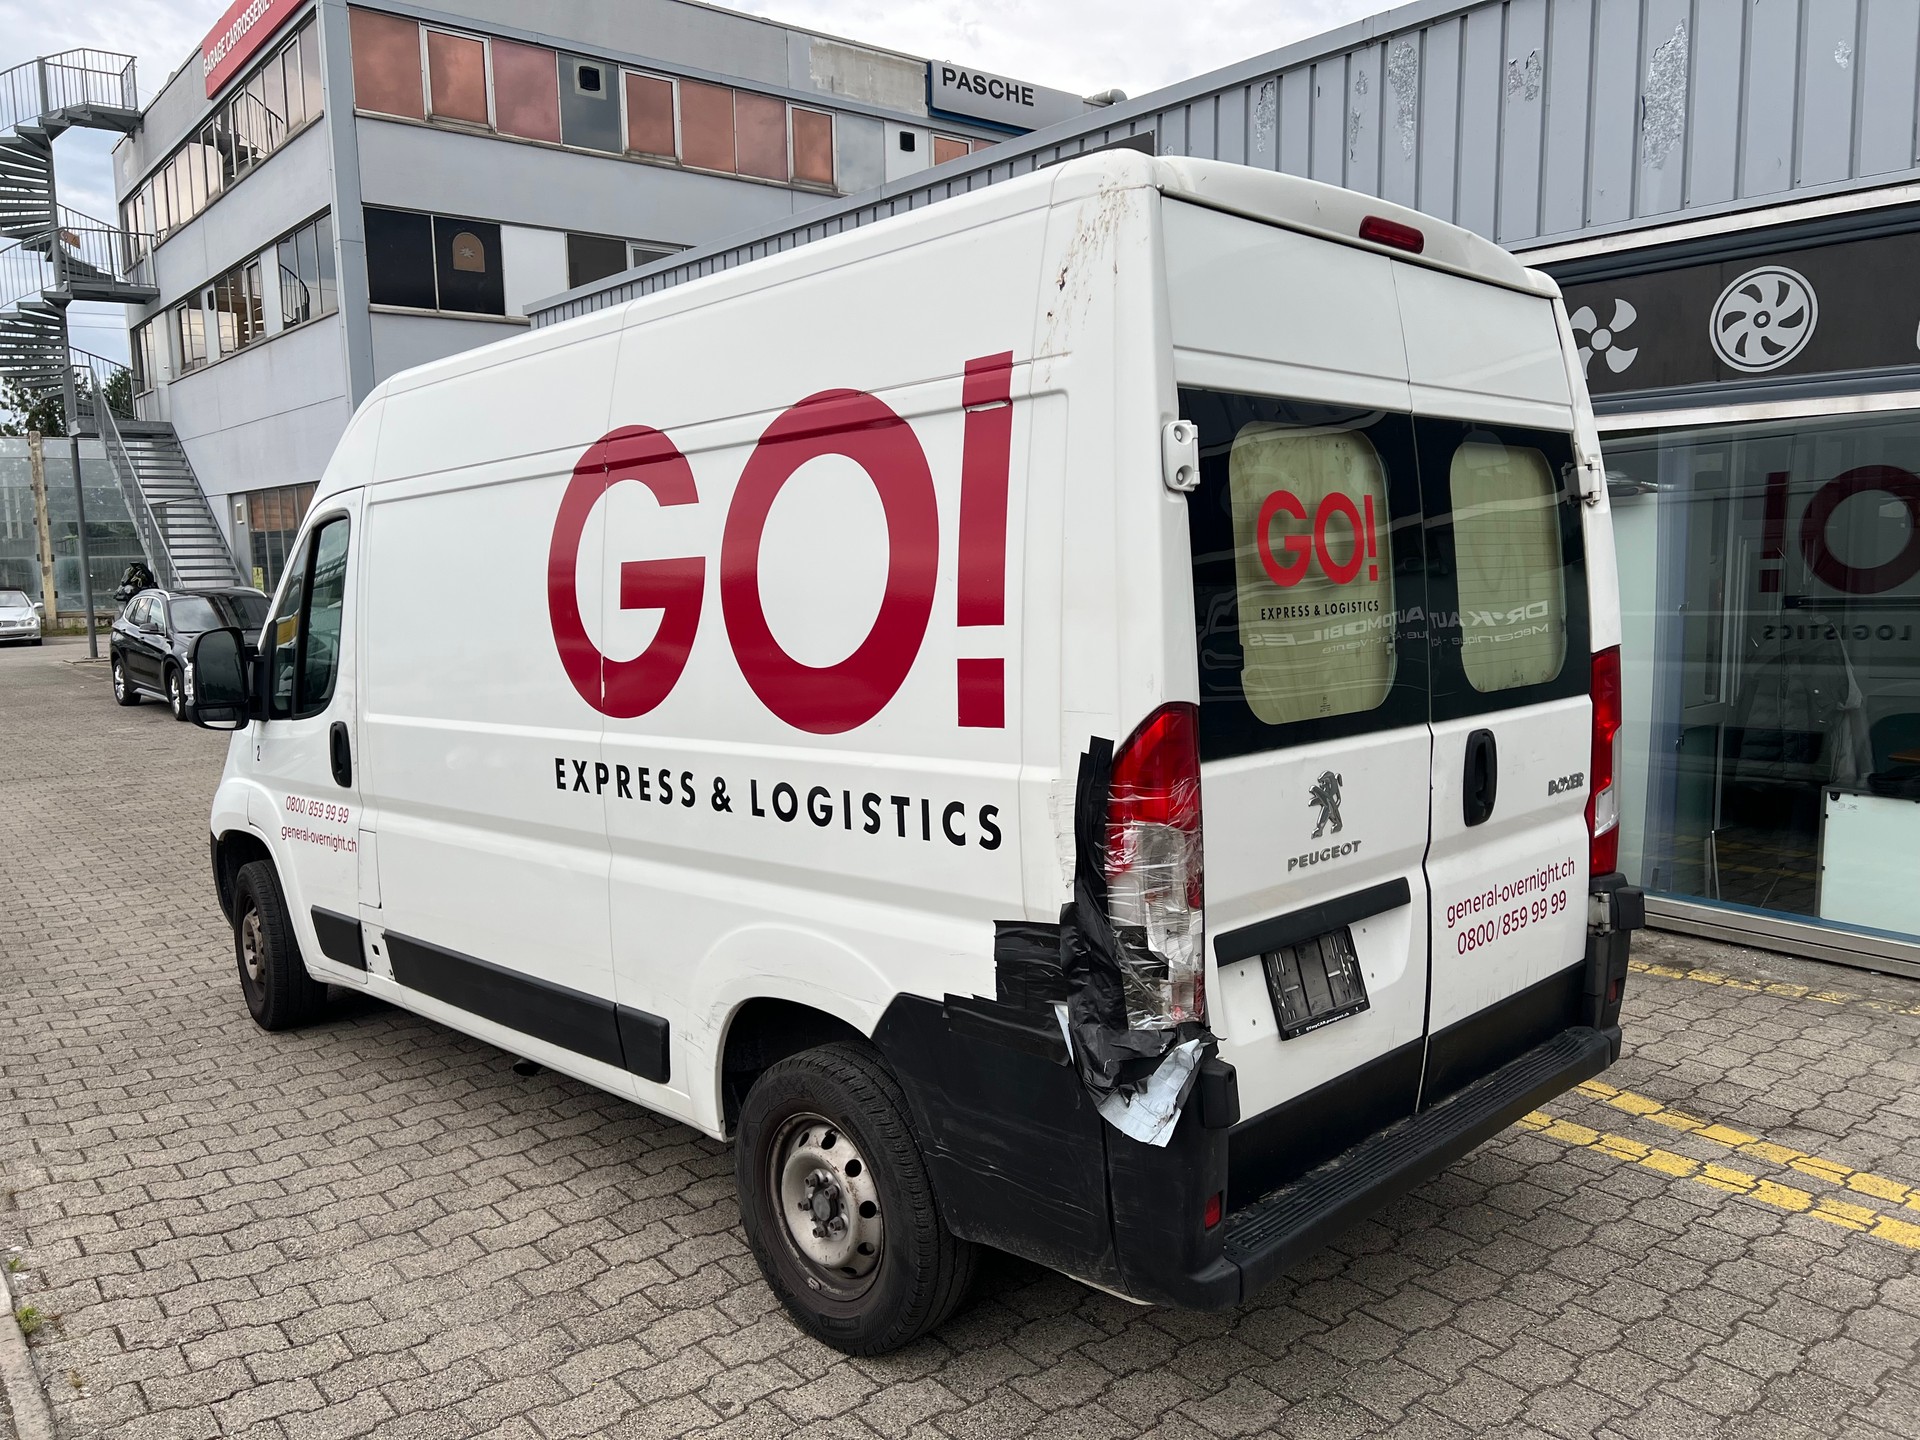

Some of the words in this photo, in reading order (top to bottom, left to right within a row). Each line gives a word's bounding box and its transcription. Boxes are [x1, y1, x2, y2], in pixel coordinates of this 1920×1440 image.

[203, 36, 226, 78] GARAGE
[942, 67, 1034, 107] PASCHE
[548, 350, 1013, 735] GO!
[1257, 490, 1379, 587] GO!
[1261, 604, 1310, 620] EXPRESS
[1314, 603, 1321, 616] &
[1325, 600, 1380, 615] LOGISTICS
[555, 758, 694, 808] EXPRESS
[711, 776, 733, 813] &
[750, 779, 1003, 851] LOGISTICS
[1548, 772, 1585, 796] BOXER
[285, 795, 324, 818] 0800/859
[325, 804, 337, 821] 99
[338, 806, 349, 824] 99
[281, 826, 357, 853] general-overnight.ch
[1287, 840, 1362, 872] PEUGEOT
[1446, 857, 1575, 928] general-overnight.ch
[1457, 909, 1528, 955] 0800/859
[1531, 897, 1548, 923] 99
[1551, 890, 1567, 916] 99
